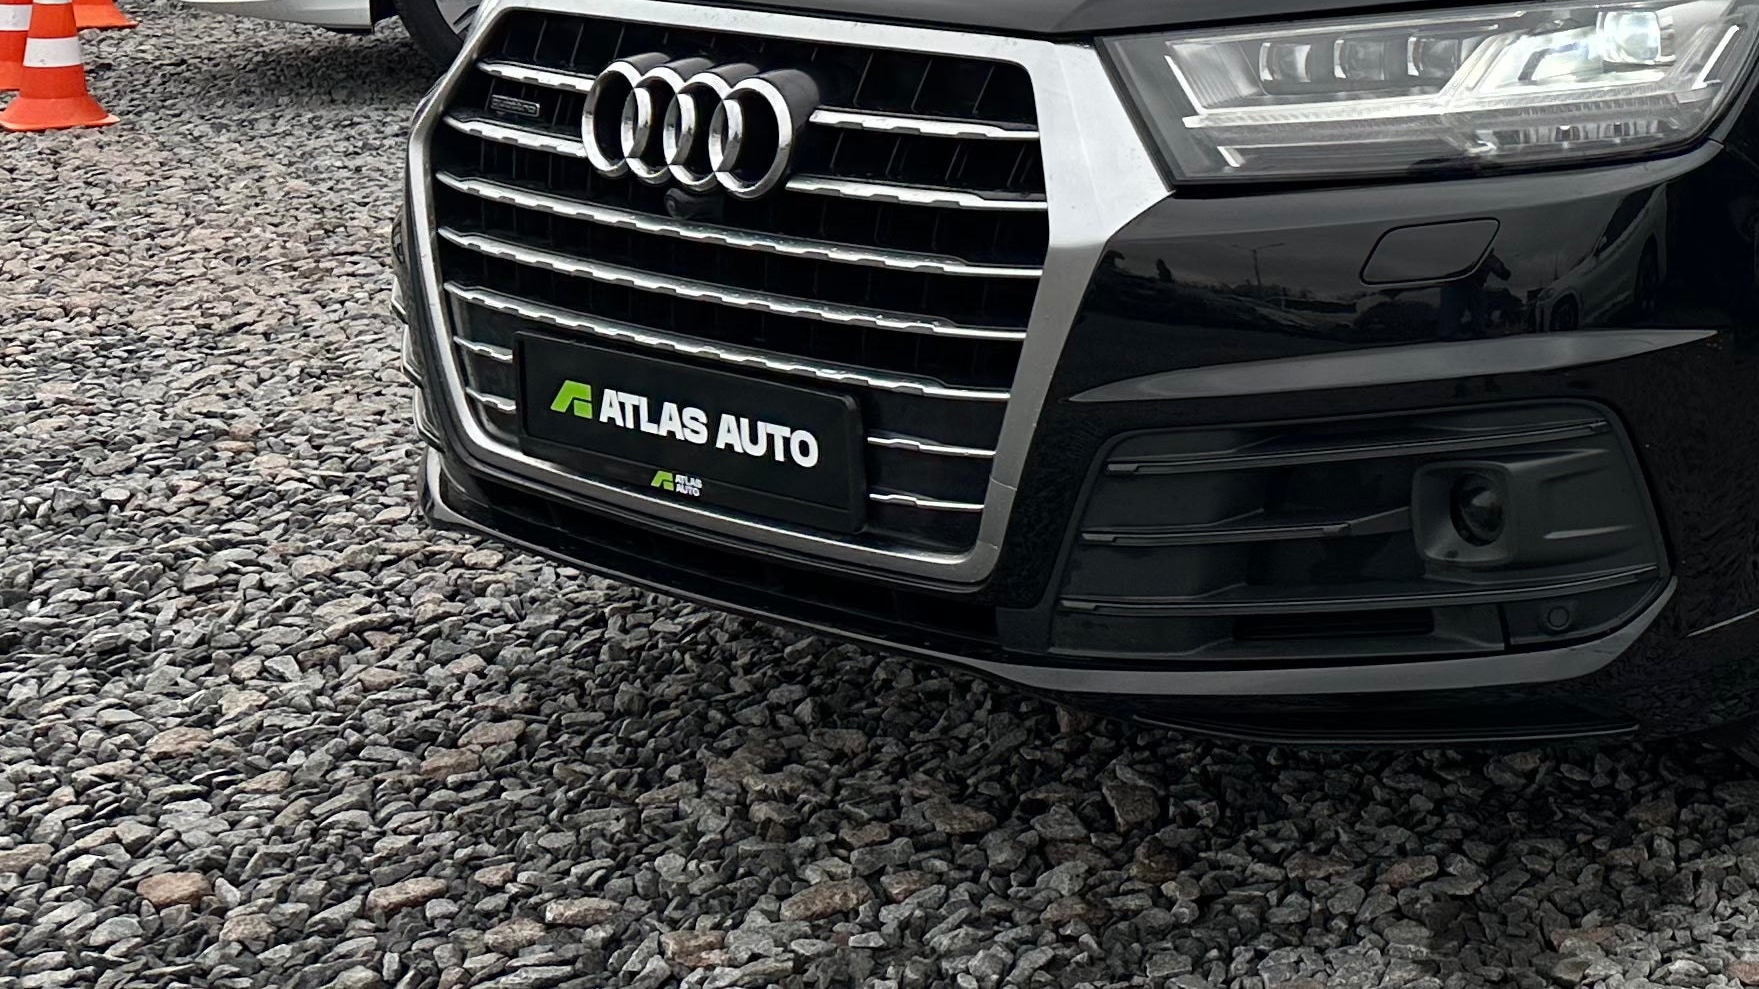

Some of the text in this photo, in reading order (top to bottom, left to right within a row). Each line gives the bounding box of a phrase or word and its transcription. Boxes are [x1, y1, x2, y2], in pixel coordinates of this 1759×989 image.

[599, 388, 819, 468] ATLAS AUTO
[675, 474, 702, 488] ATLAS
[675, 483, 700, 497] AUTO
